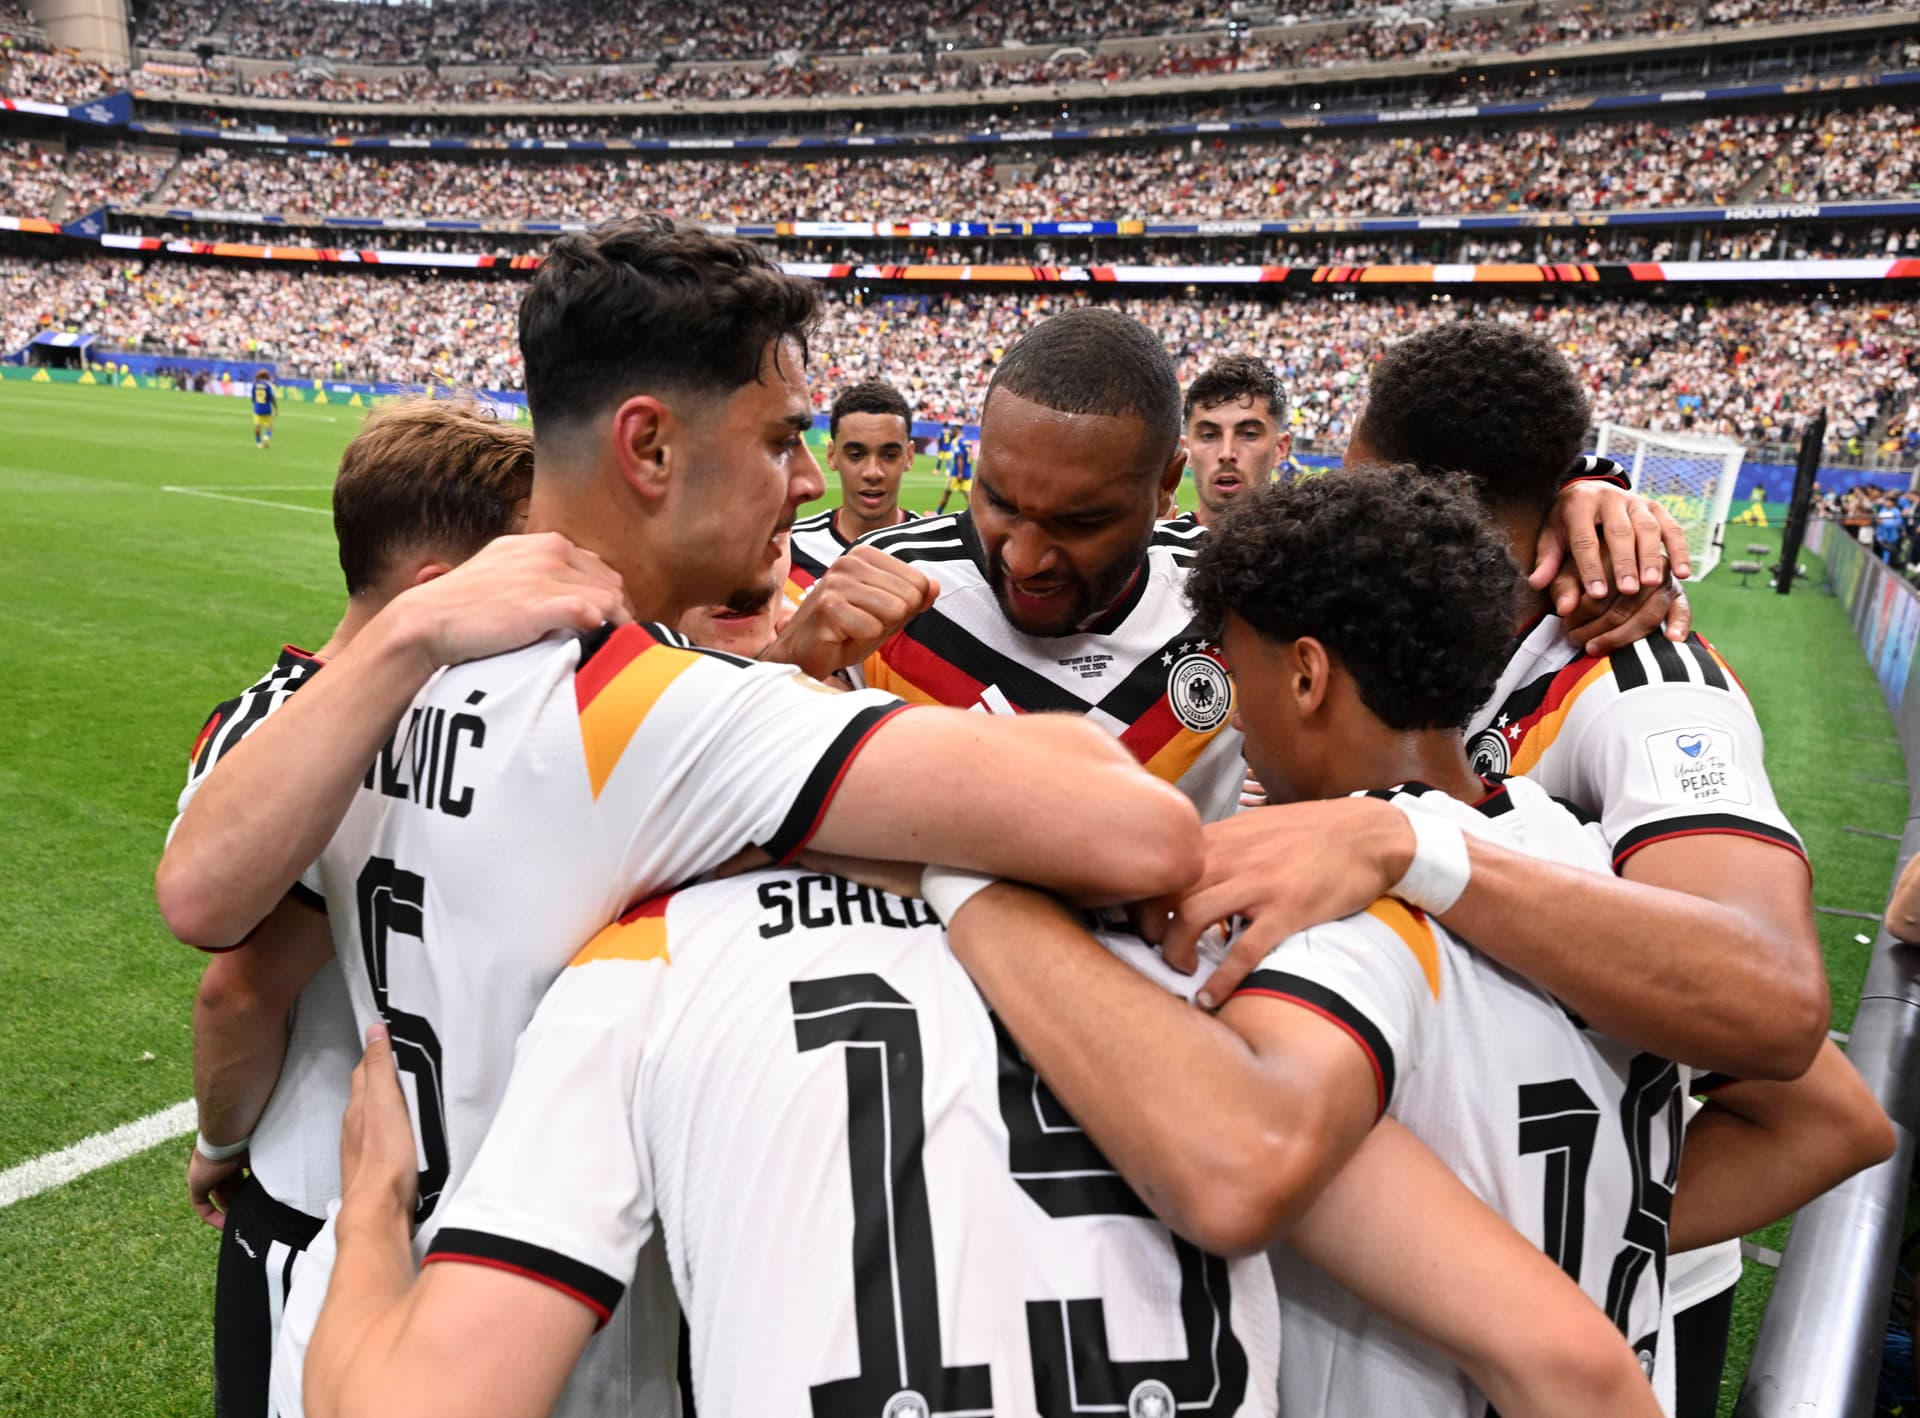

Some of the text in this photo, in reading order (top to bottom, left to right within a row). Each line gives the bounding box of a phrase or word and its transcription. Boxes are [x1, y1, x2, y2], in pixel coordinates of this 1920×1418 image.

[1725, 206, 1820, 220] HOUSTON
[1198, 222, 1262, 233] HOUSTON
[1181, 665, 1214, 683] DEUTSCHER
[1681, 771, 1728, 792] PEACE
[1694, 788, 1720, 799] FIFA
[357, 855, 450, 1224] 6
